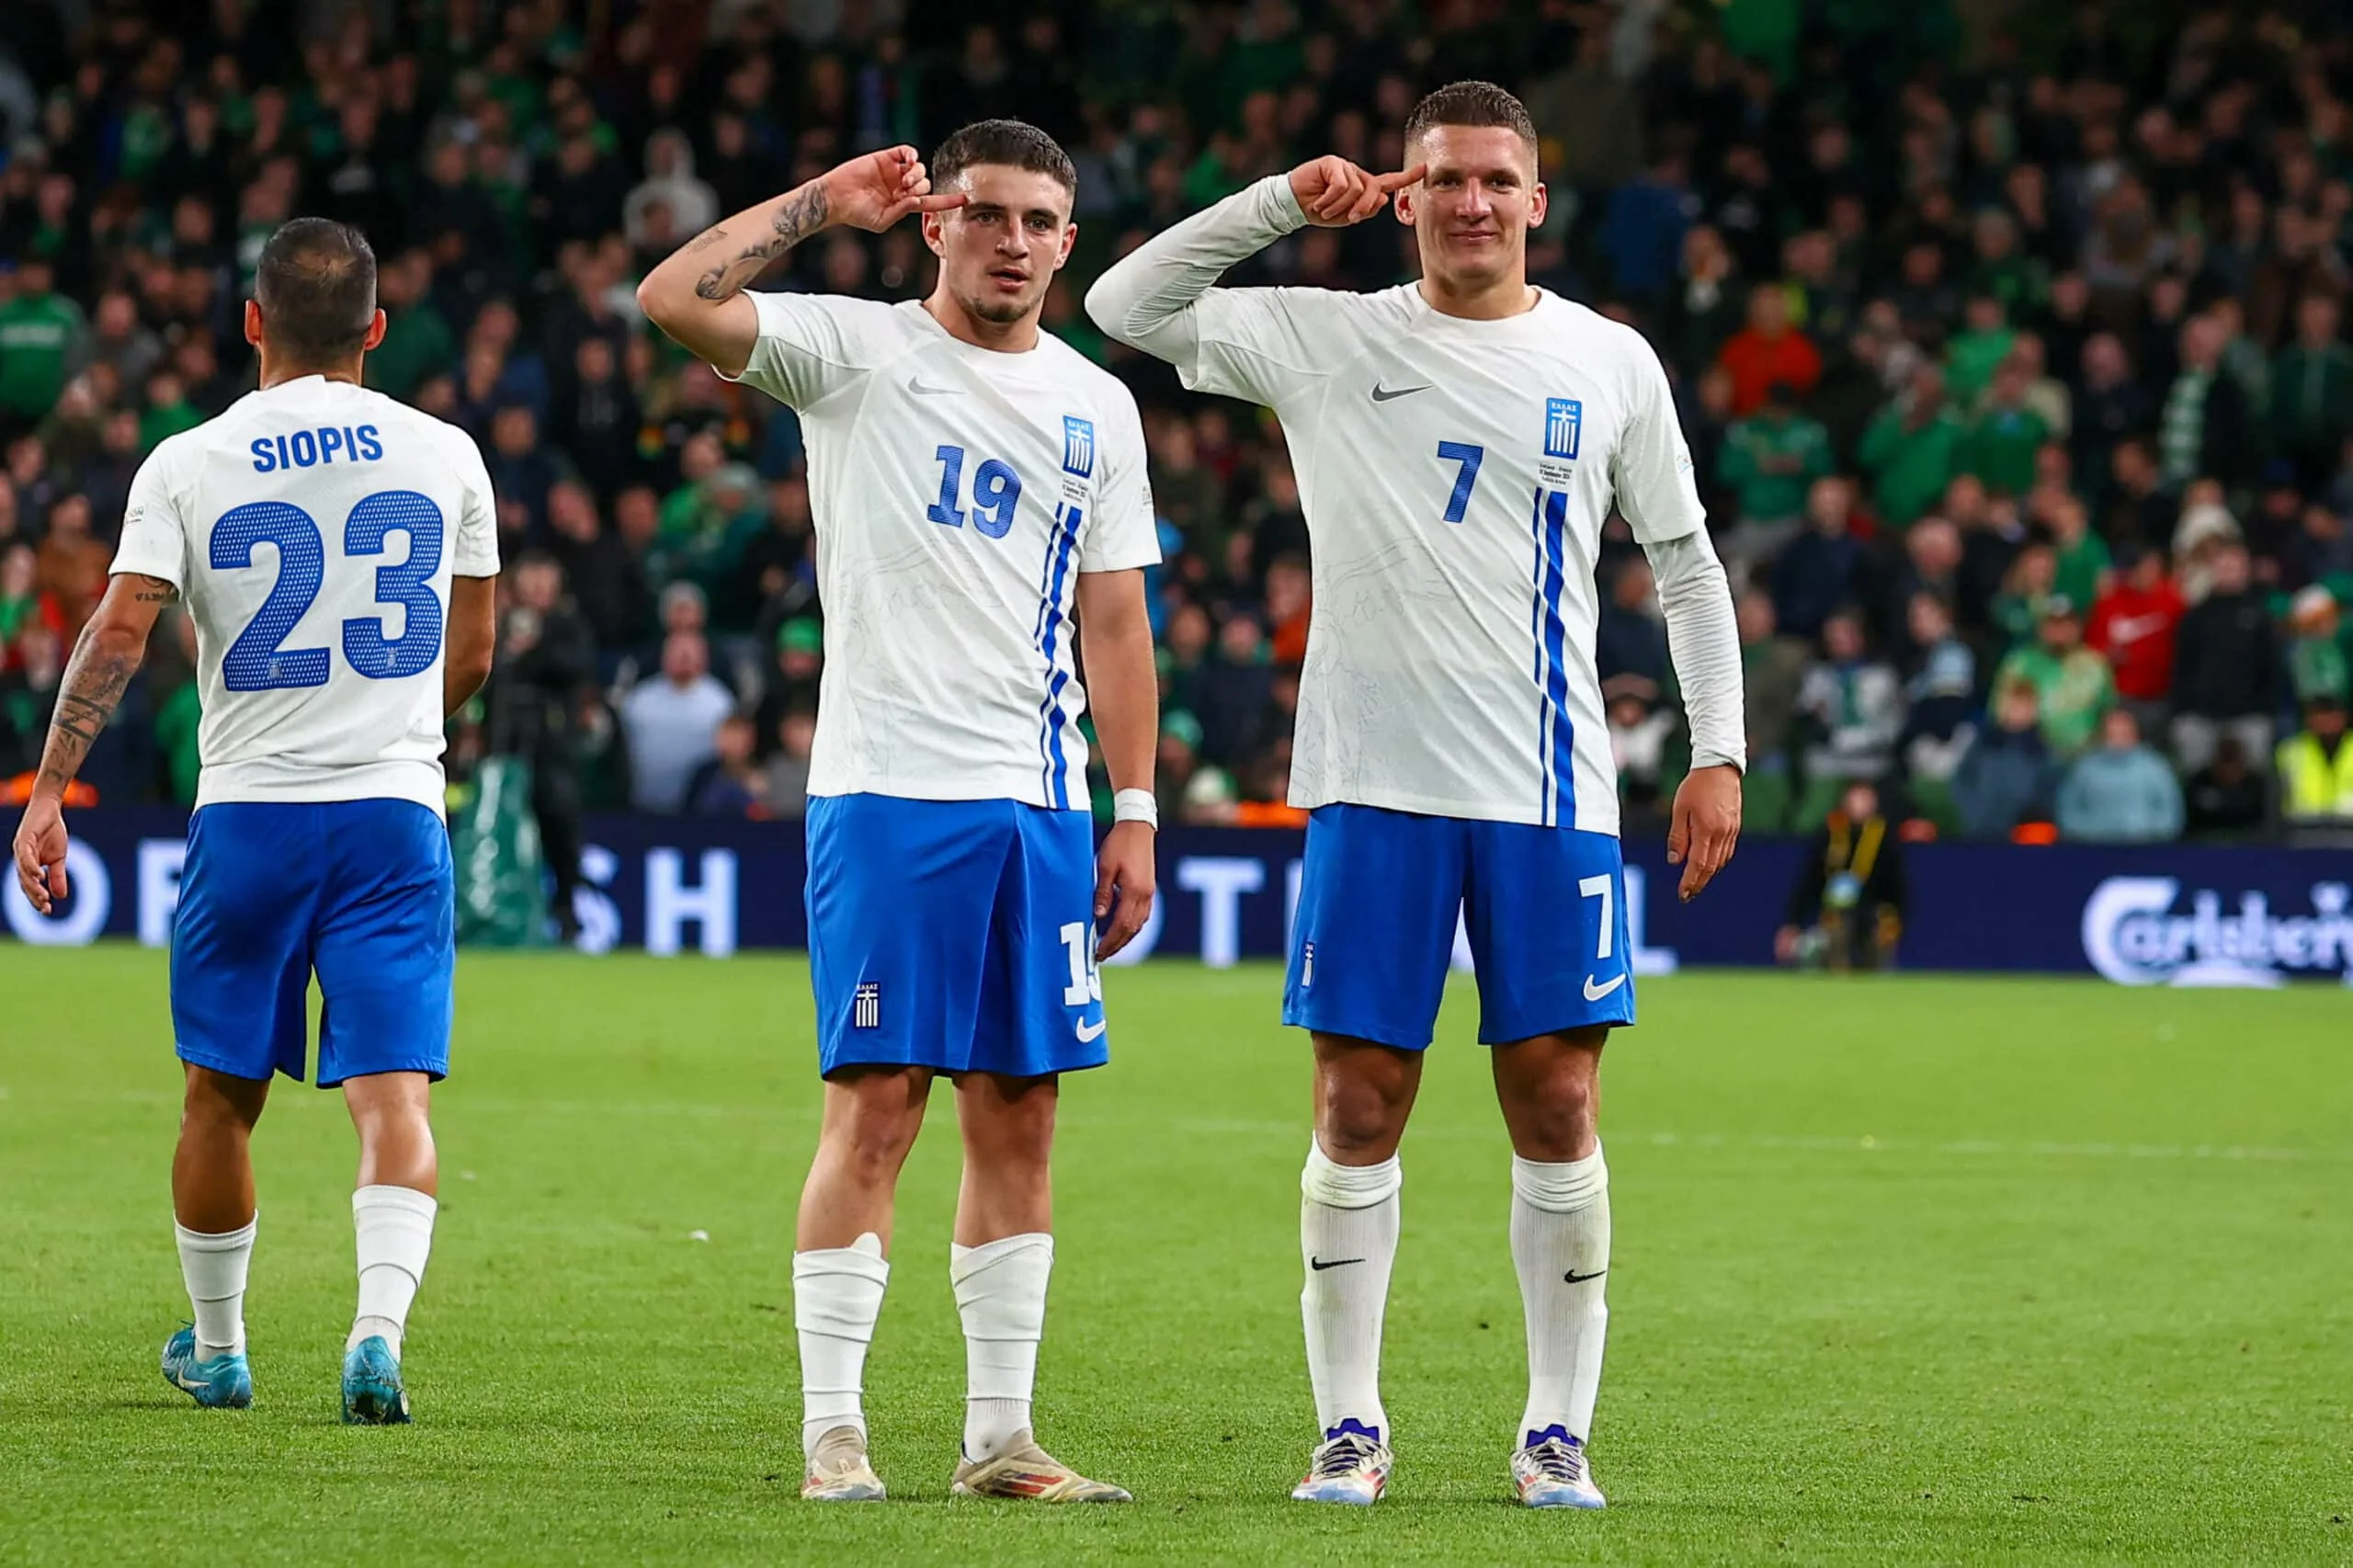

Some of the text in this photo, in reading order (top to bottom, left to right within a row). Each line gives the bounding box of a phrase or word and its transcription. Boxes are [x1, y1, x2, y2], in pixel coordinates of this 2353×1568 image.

[251, 425, 383, 472] SIOPIS
[926, 445, 1021, 540] 19
[1437, 441, 1483, 523] 7
[210, 490, 444, 691] 23
[1578, 873, 1613, 960] 7
[2081, 876, 2353, 987] Carlsber
